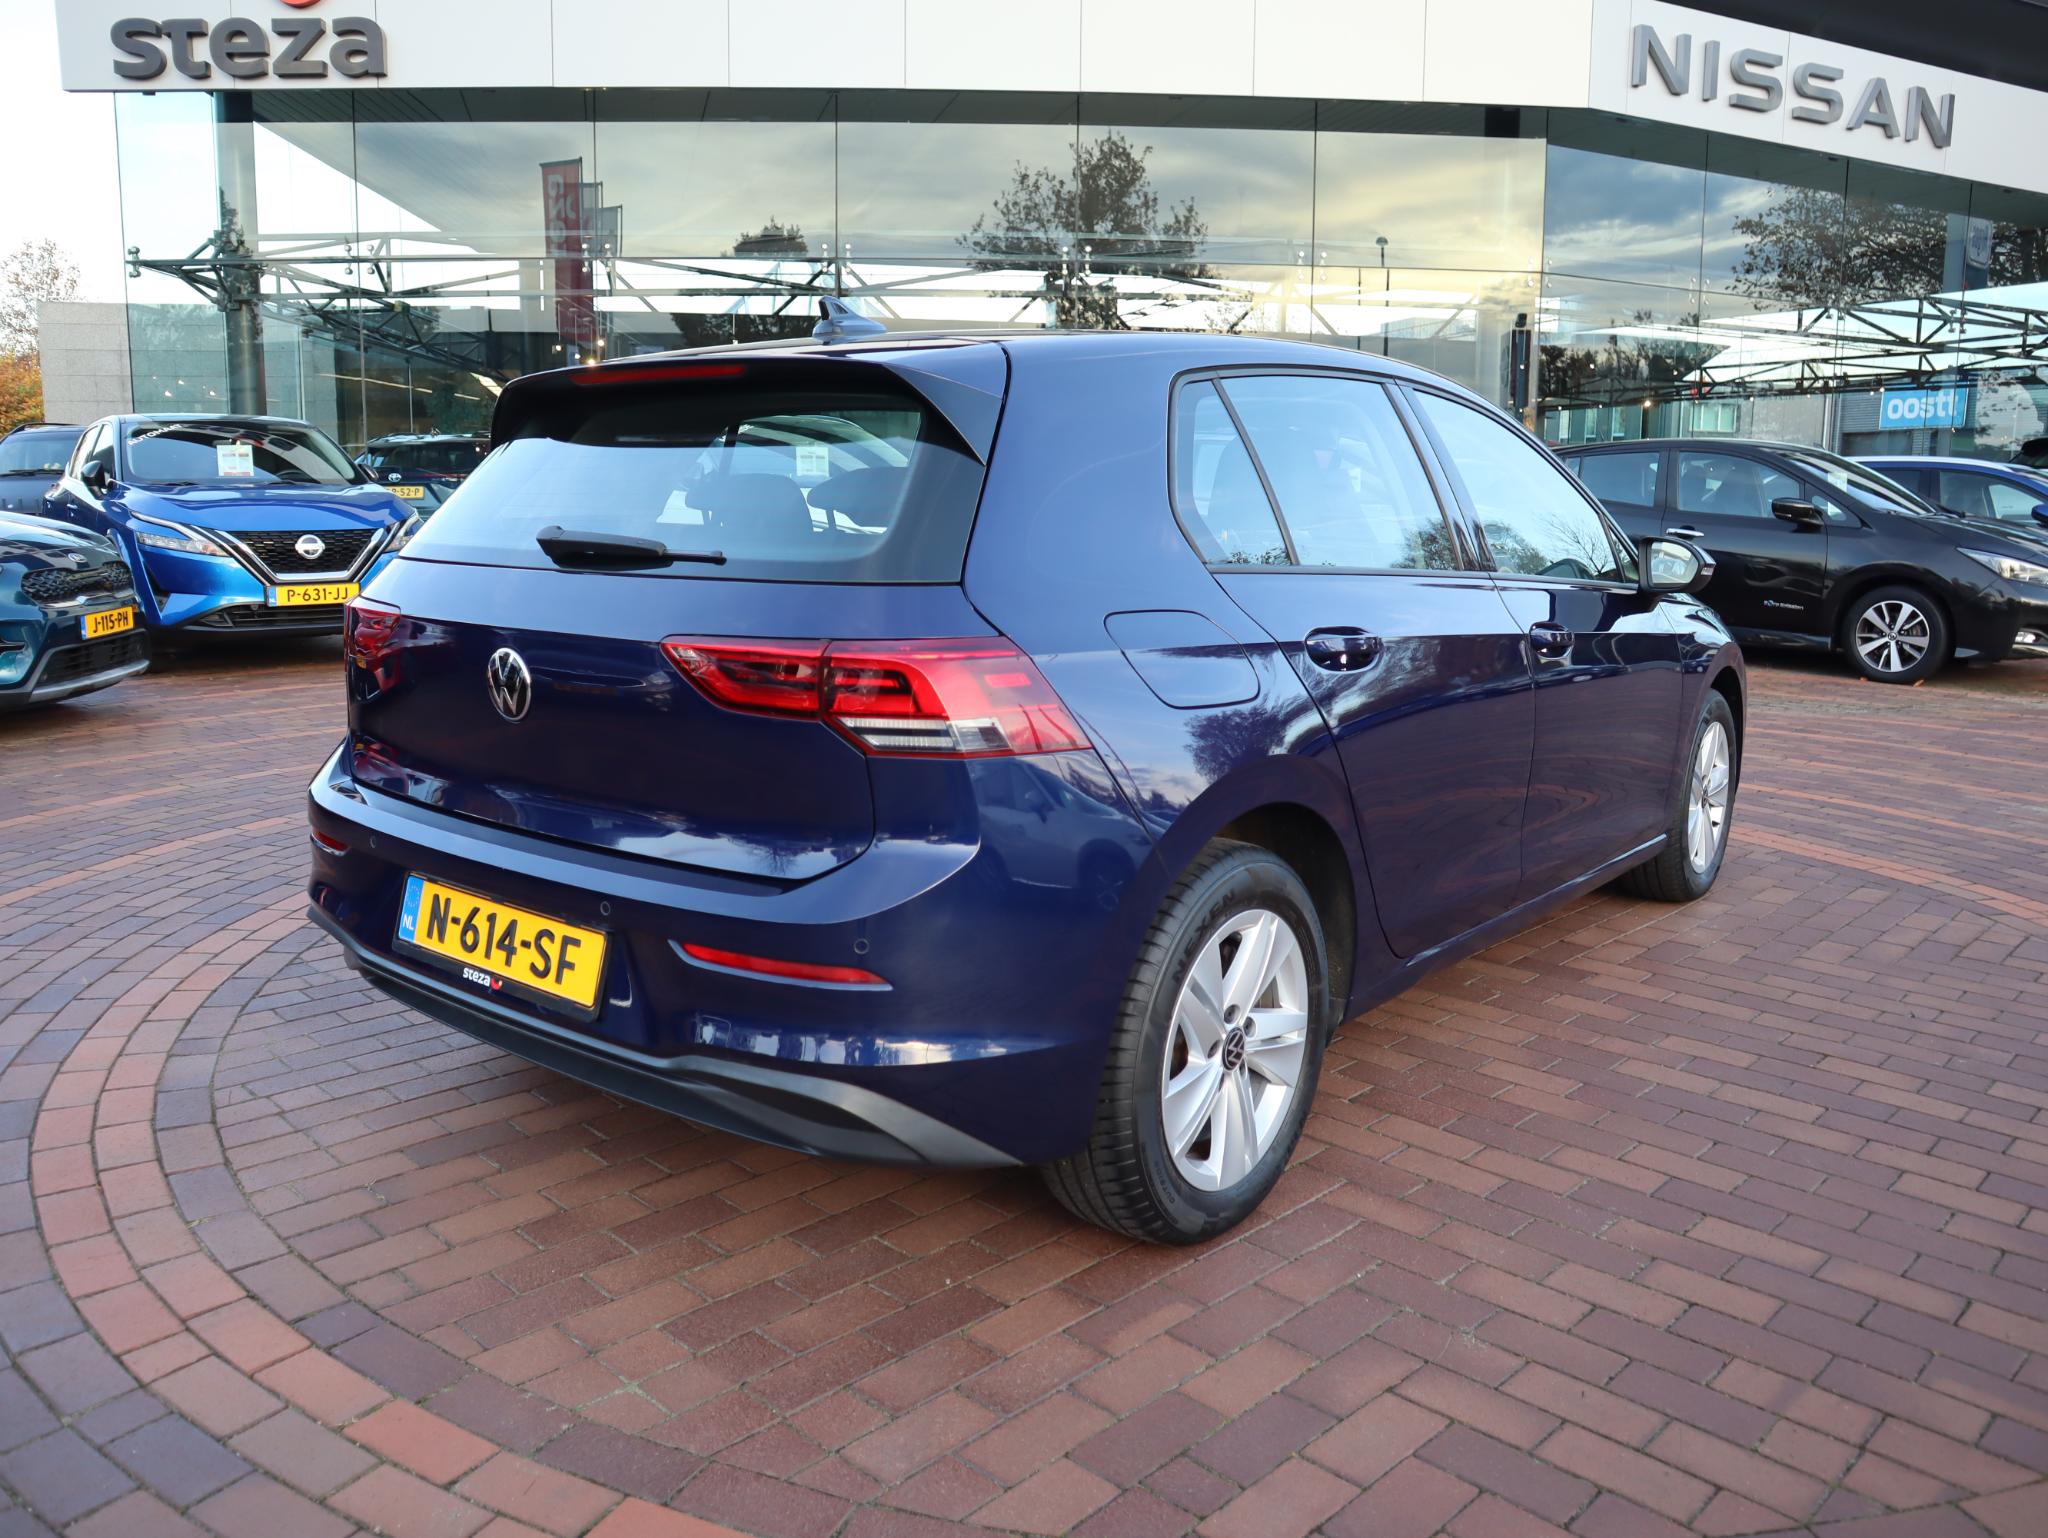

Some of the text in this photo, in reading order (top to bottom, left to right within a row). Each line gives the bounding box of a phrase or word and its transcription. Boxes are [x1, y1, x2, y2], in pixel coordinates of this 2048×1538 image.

[110, 16, 388, 79] steza
[1631, 24, 1956, 149] NISSAN
[287, 587, 348, 602] P-631-JJ
[93, 610, 129, 633] J-115-PH
[402, 913, 414, 931] NL
[426, 893, 581, 985] N-614-SF
[463, 967, 491, 986] steza
